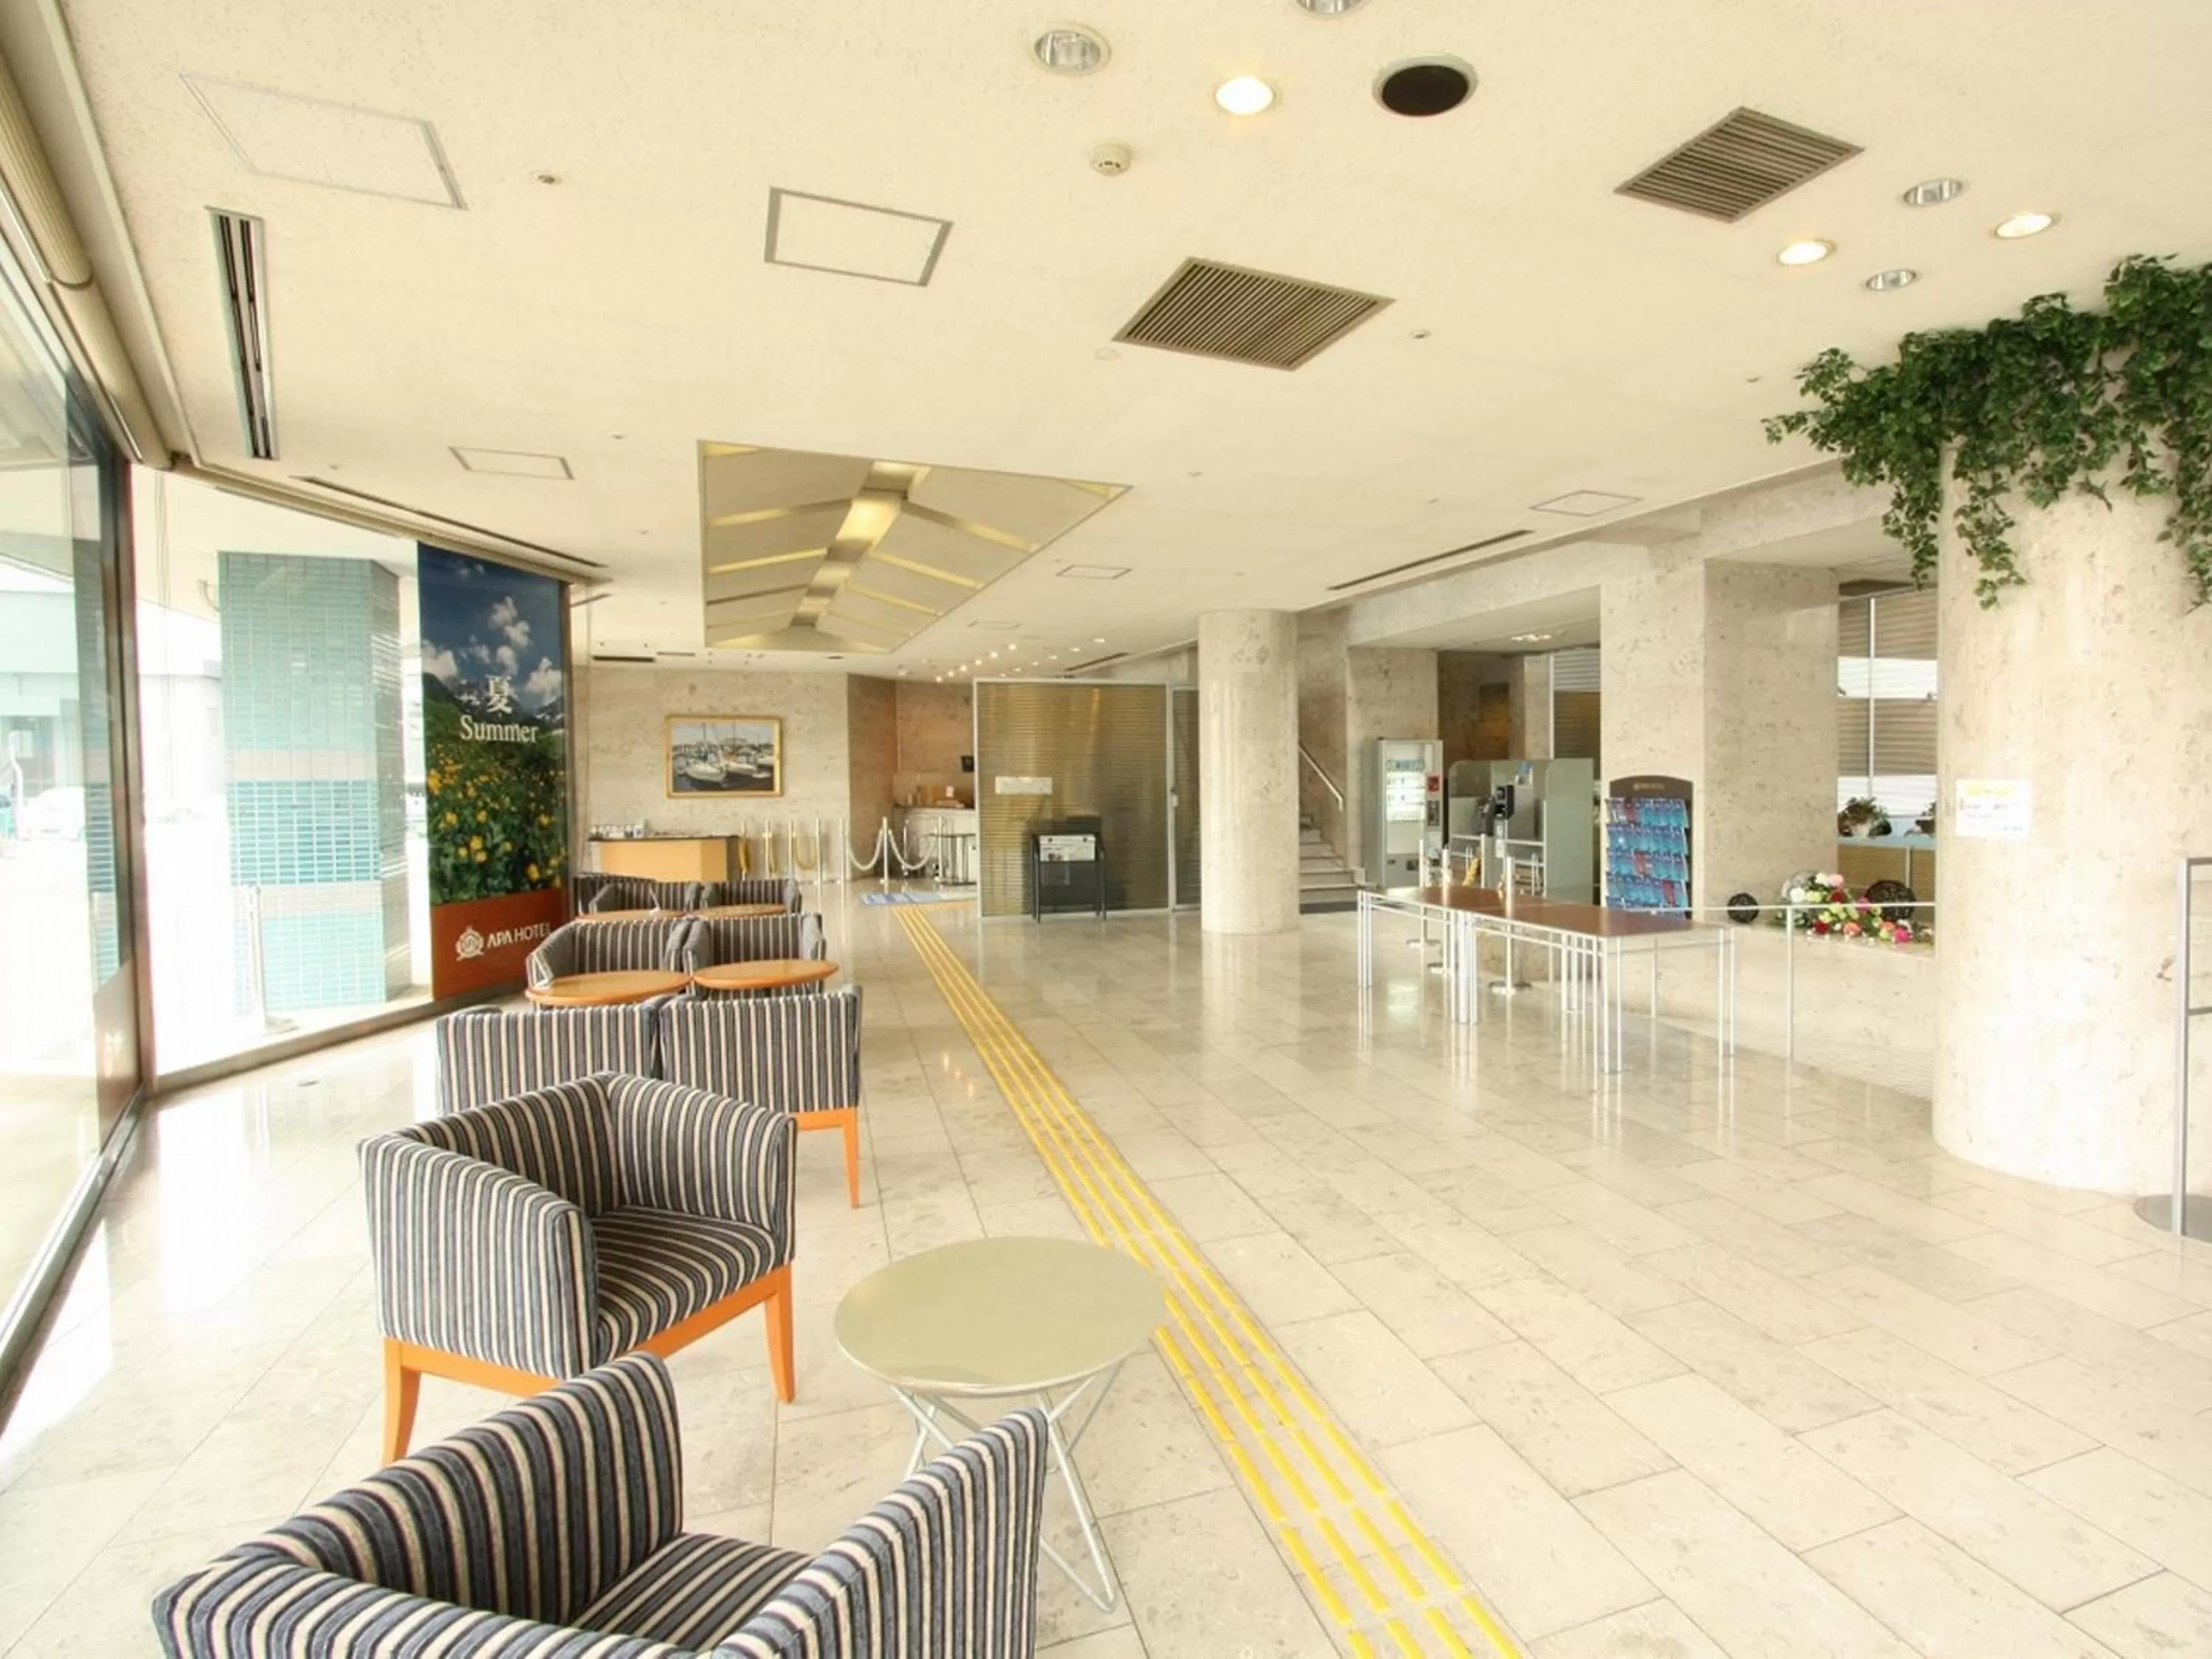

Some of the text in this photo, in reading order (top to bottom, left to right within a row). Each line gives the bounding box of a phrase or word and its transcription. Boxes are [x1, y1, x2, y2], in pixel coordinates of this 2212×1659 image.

[485, 674, 515, 714] 夏
[459, 714, 540, 743] Summer
[487, 922, 551, 949] APA HOTEL
